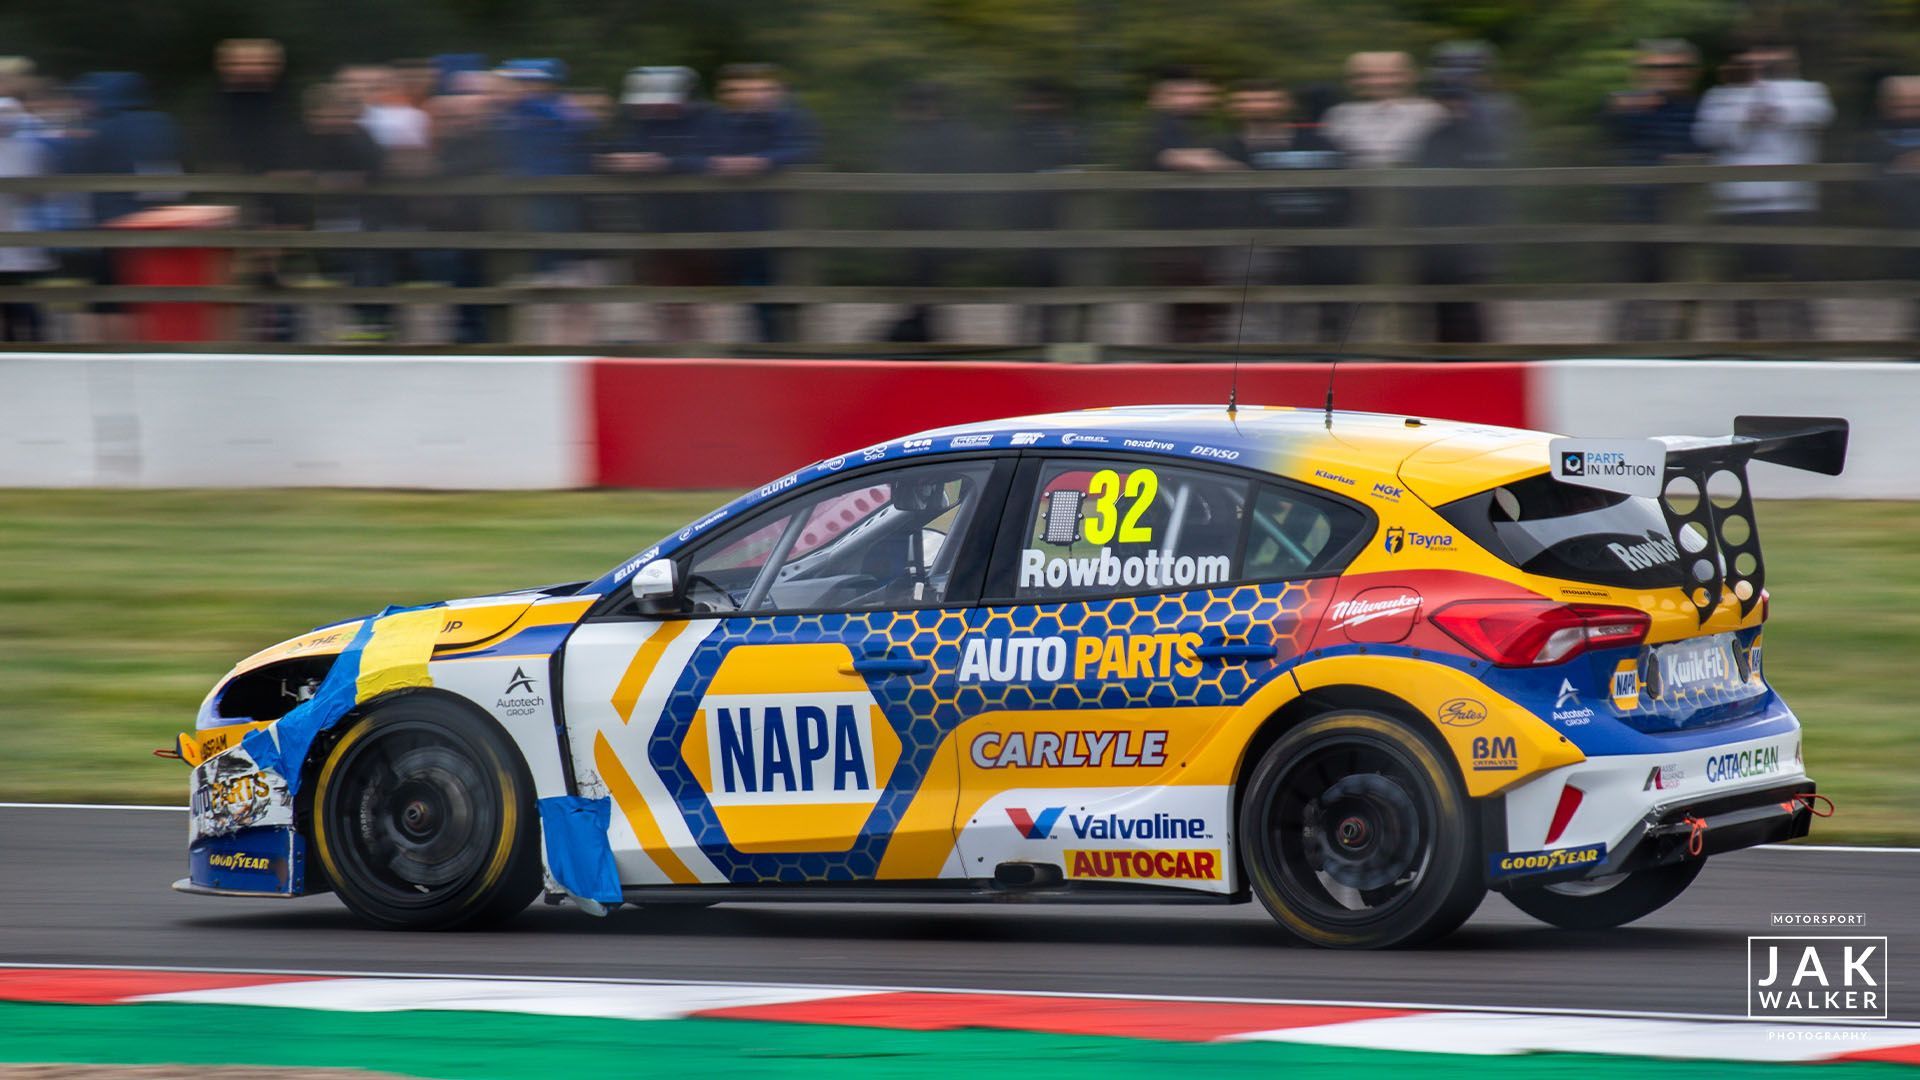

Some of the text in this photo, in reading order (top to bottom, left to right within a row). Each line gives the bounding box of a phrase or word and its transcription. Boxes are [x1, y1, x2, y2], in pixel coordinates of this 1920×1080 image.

[1123, 439, 1174, 451] nexdrive
[1190, 445, 1240, 460] DENSO
[1586, 453, 1624, 464] PARTS
[1315, 469, 1356, 486] Klarius
[1587, 464, 1656, 477] IN MOTION
[761, 475, 797, 497] CLUTCH
[1373, 482, 1404, 499] NGK
[1084, 468, 1158, 545] 32
[1408, 532, 1452, 548] Tayna
[1020, 547, 1231, 588] Rowbottom
[1330, 594, 1424, 622] Milwaukee
[310, 634, 340, 647] THE
[958, 632, 1204, 683] AUTO PARTS
[496, 696, 544, 708] Autotech
[506, 708, 535, 716] GROUP
[1445, 702, 1482, 720] Gates
[1552, 707, 1594, 721] Autotech
[1565, 718, 1590, 727] GROUP
[717, 705, 870, 793] NAPA
[970, 730, 1168, 770] CARLYLE
[1472, 736, 1517, 759] BM
[1706, 746, 1778, 783] CATACLEAN
[209, 853, 269, 869] GOODYEAR
[1073, 852, 1214, 878] AUTOCAR
[1501, 849, 1598, 870] GOODYEAR
